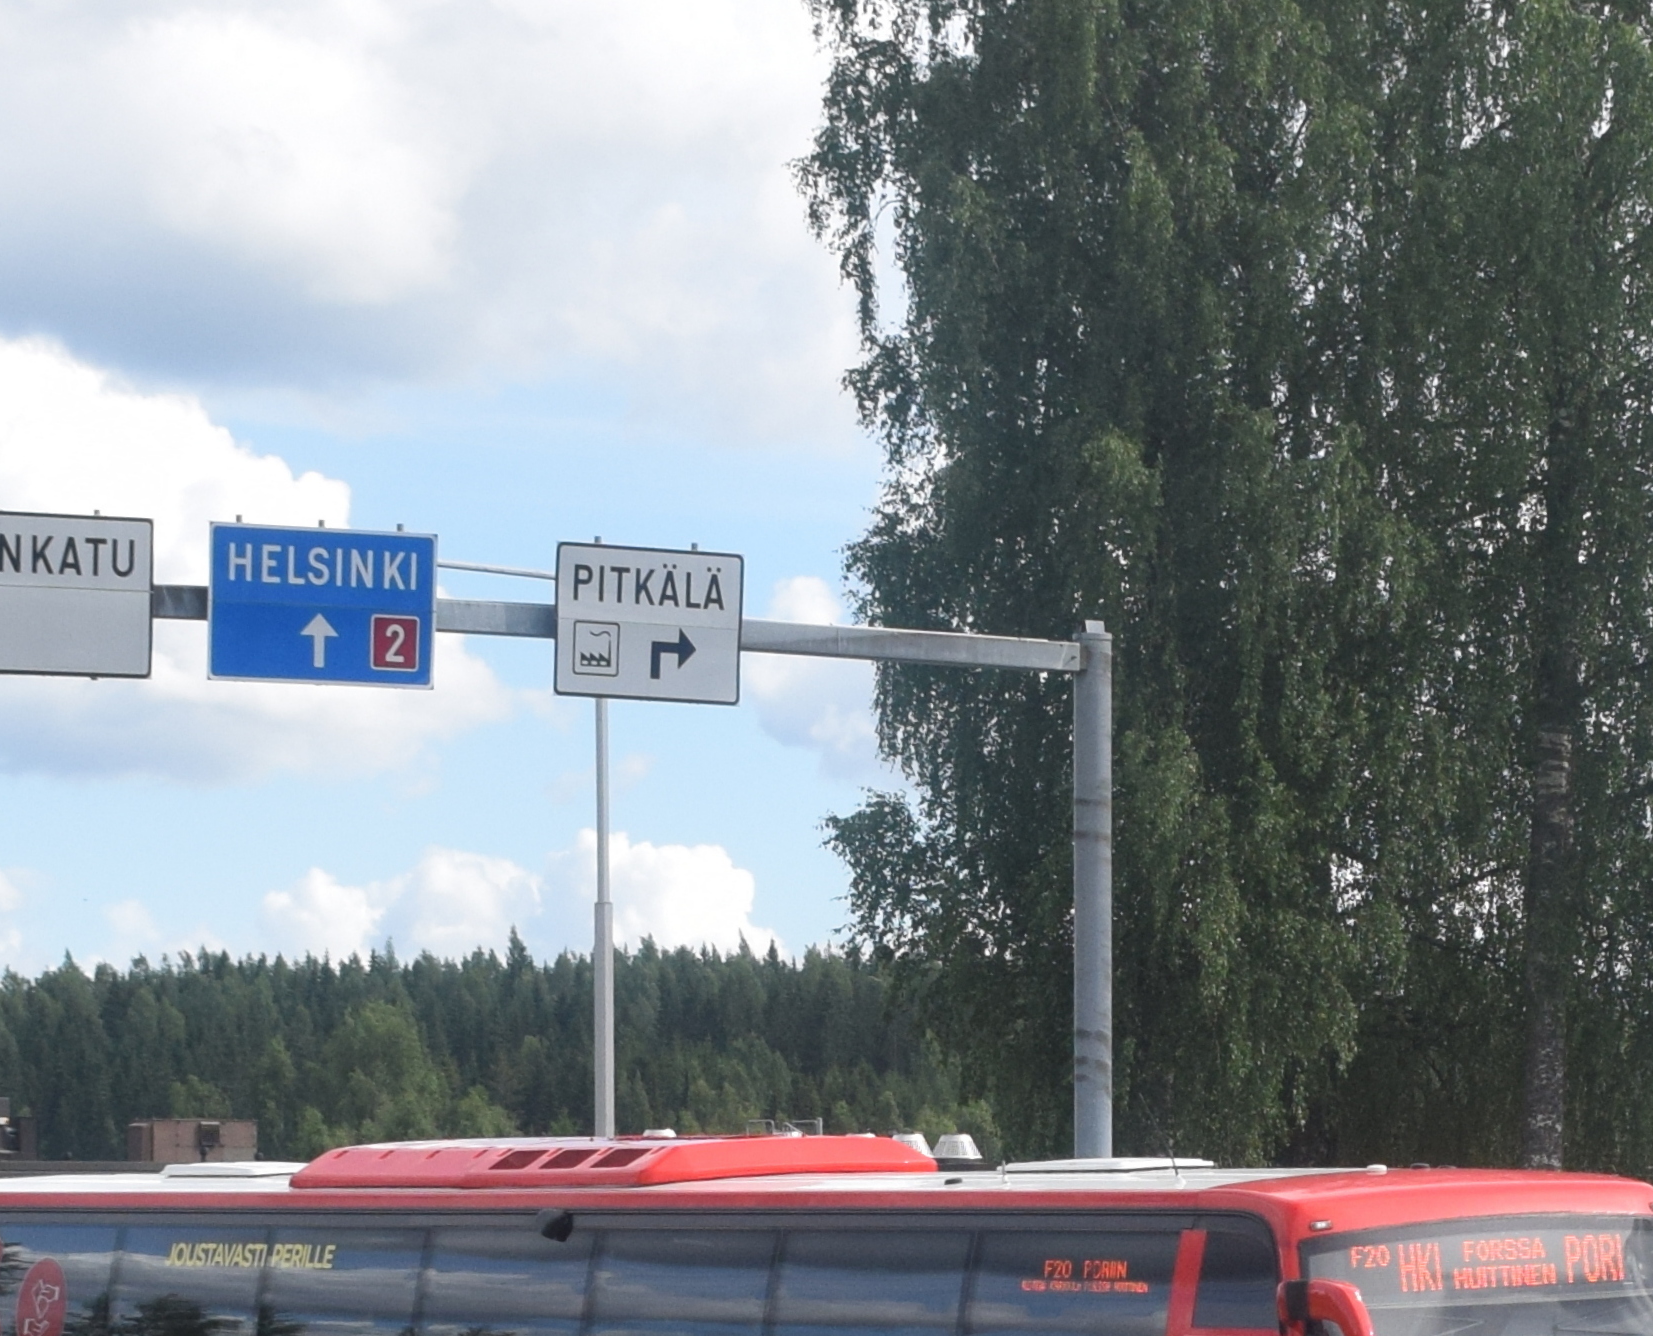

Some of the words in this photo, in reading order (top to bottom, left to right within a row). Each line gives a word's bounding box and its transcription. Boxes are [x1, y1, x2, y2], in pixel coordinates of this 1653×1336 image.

[228, 542, 418, 591] HELSINKI
[573, 563, 725, 611] PITKÄLÄ
[384, 623, 406, 663] 2
[165, 1242, 268, 1268] JOUSTAVASTI
[271, 1243, 336, 1269] PERILLE
[1398, 1241, 1444, 1292] HKI
[1563, 1233, 1626, 1284] PORI
[1462, 1237, 1547, 1262] FORSSA
